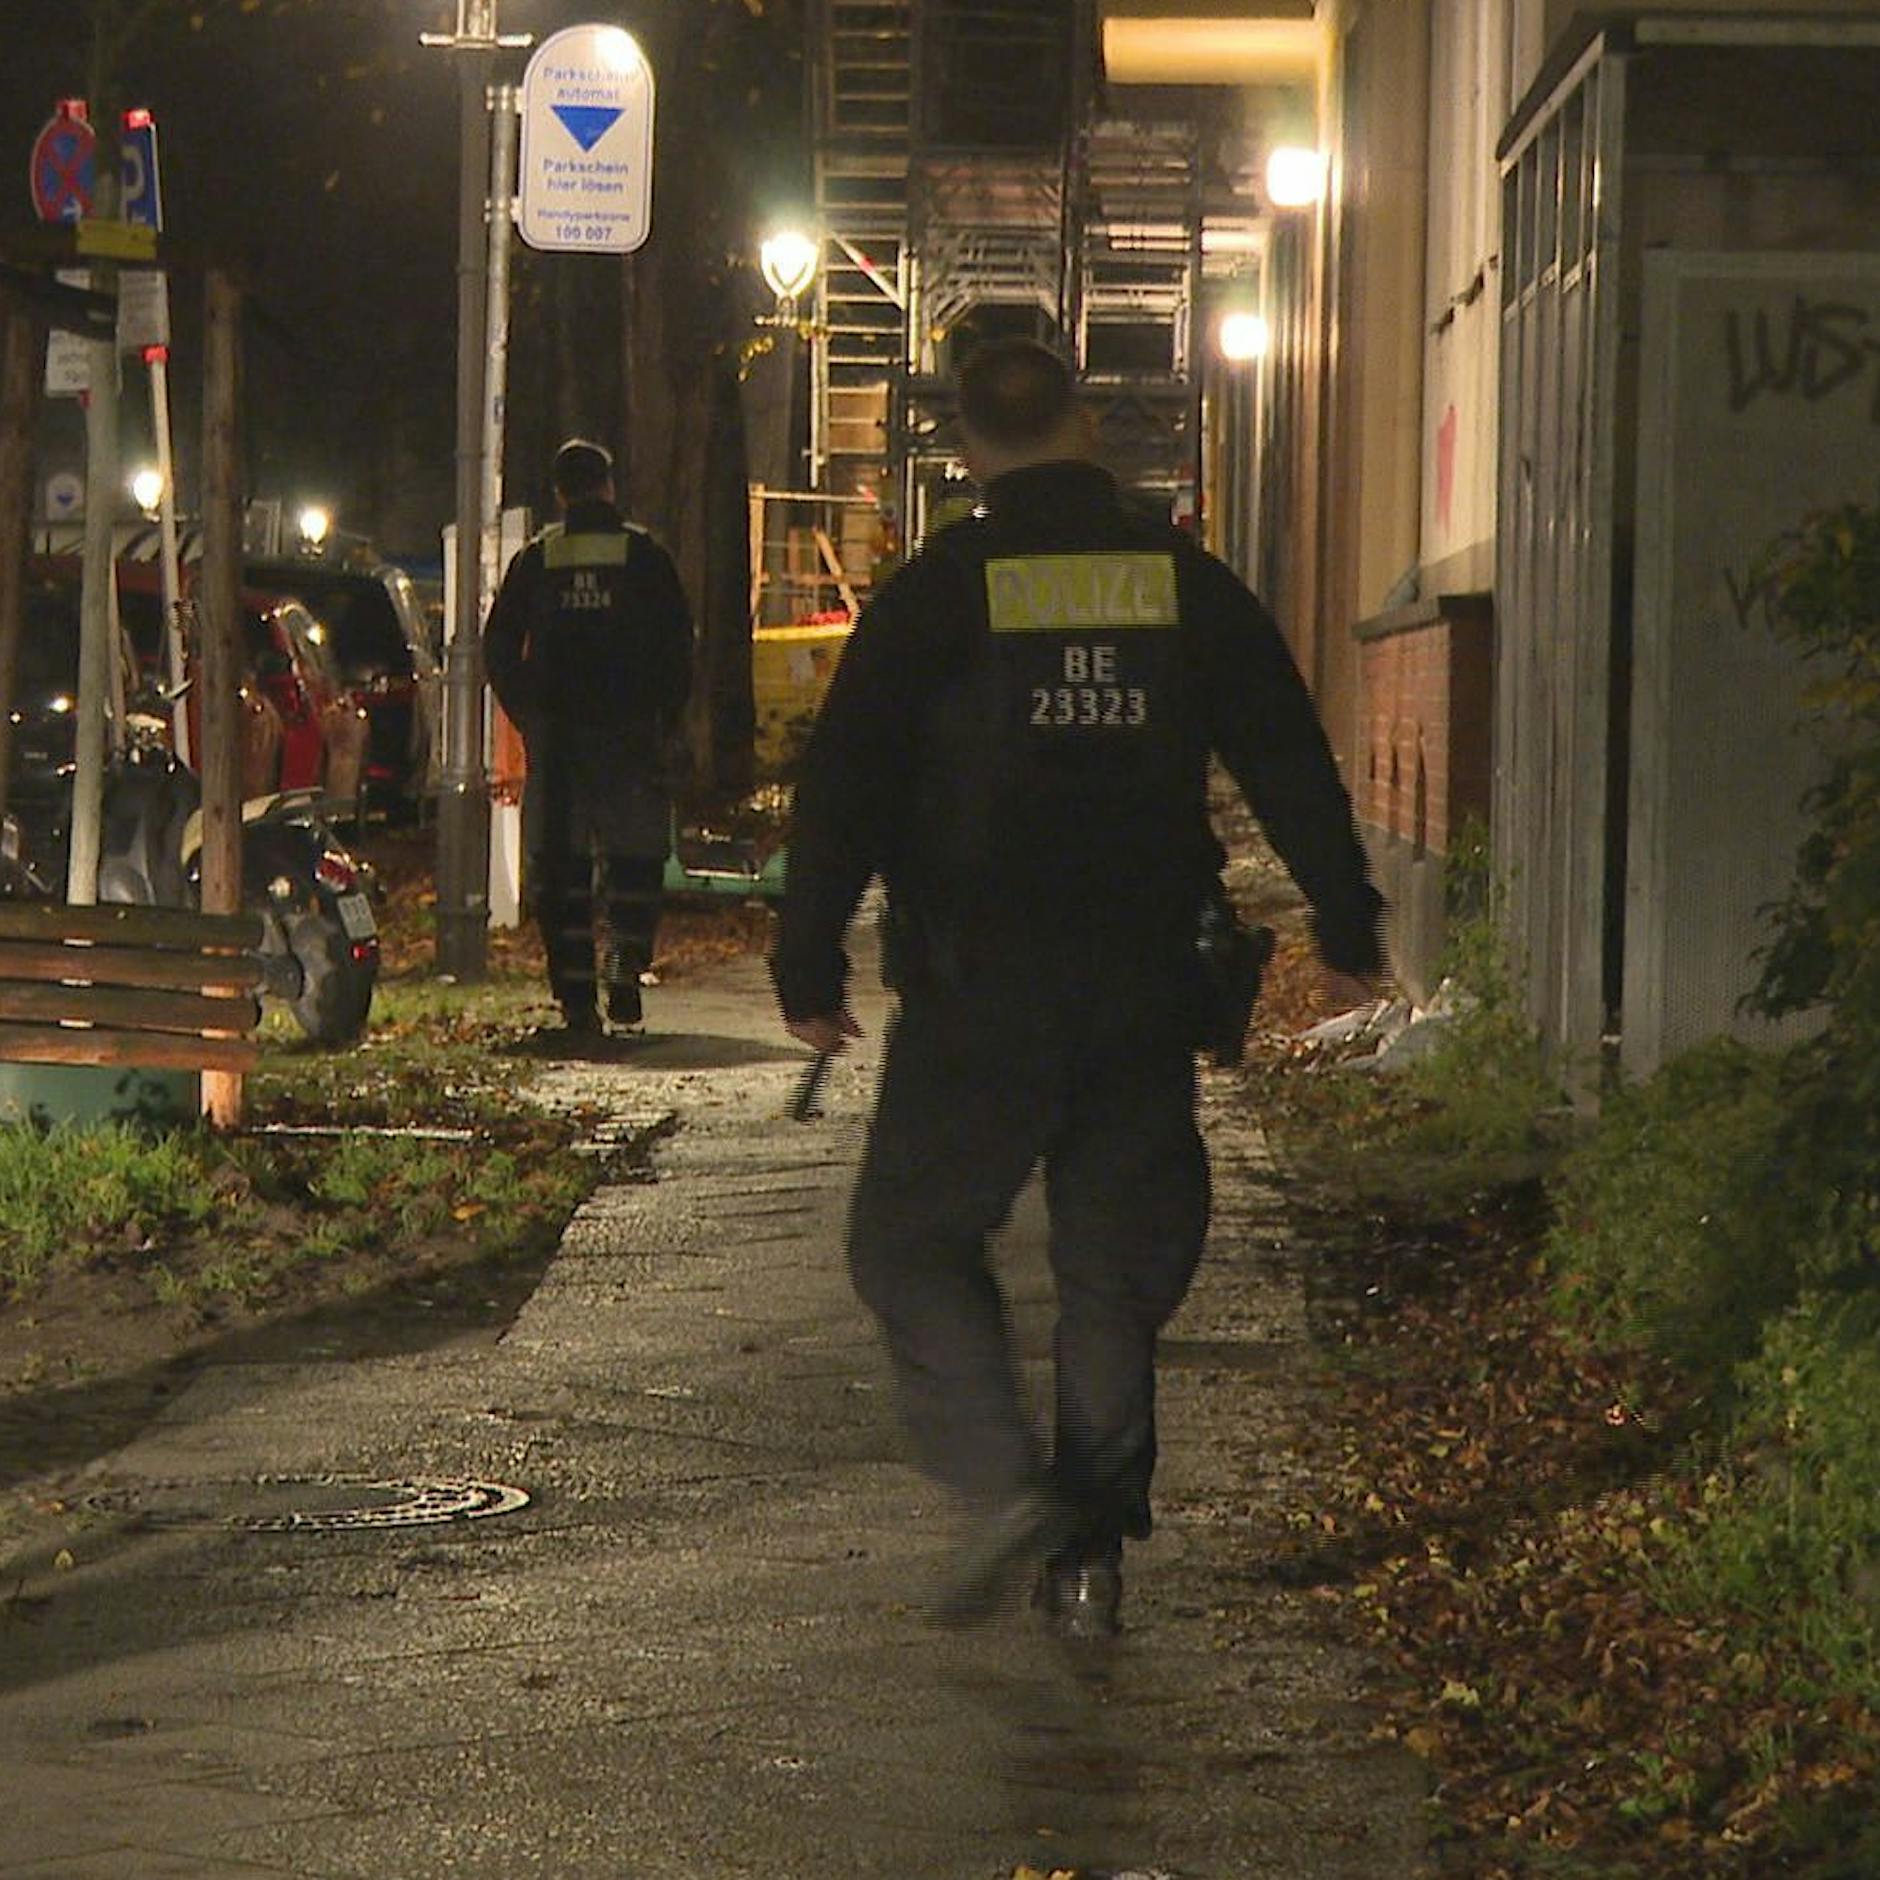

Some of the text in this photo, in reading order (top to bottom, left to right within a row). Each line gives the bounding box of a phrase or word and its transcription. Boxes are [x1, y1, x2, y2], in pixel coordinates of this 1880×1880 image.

[543, 158, 629, 174] Parkschein
[547, 178, 577, 191] hier
[1063, 646, 1117, 683] BE
